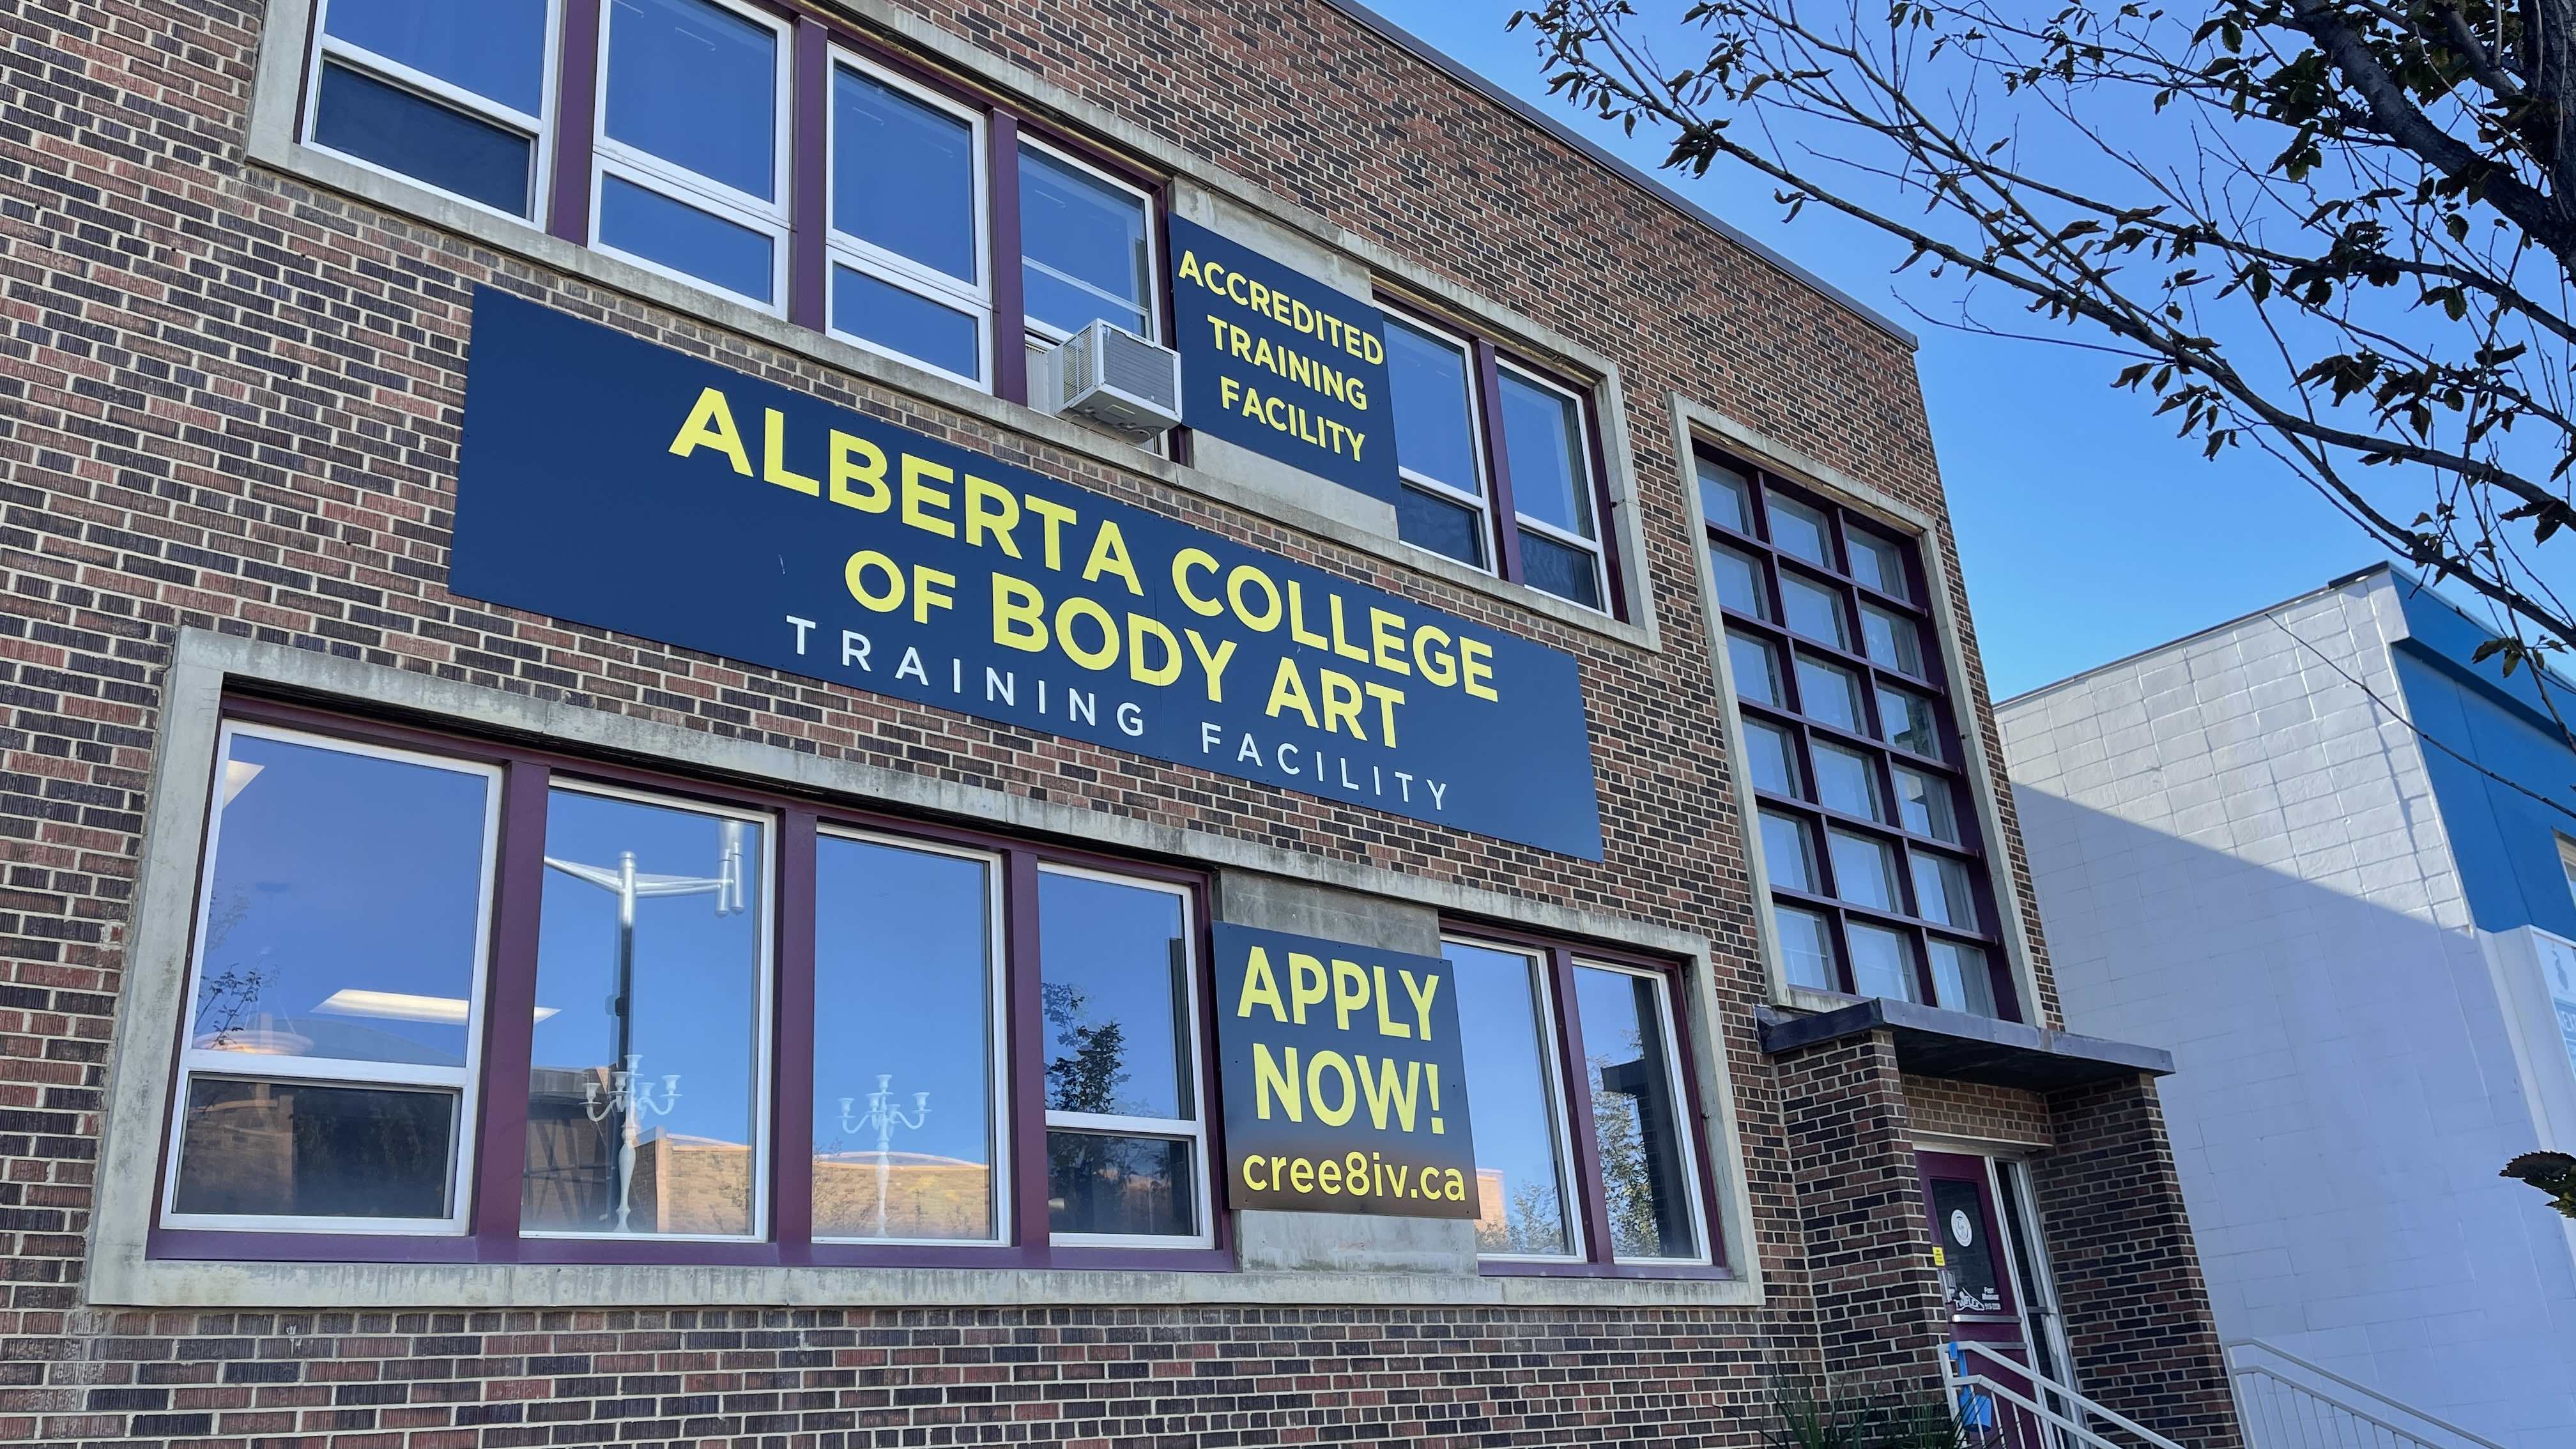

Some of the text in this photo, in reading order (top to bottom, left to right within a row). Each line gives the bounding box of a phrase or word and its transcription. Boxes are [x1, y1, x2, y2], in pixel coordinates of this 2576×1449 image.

[1178, 250, 1384, 365] ACCREDITED
[1207, 314, 1367, 410] TRAINING
[1220, 375, 1365, 462] FACILITY
[668, 387, 1498, 703] ALBERTA COLLEGE
[845, 550, 1405, 748] OF BODY ART
[786, 615, 1446, 810] TRAINING FACILITY
[1237, 946, 1439, 1041] APPLY
[1252, 1043, 1445, 1135] NOW!
[1242, 1151, 1466, 1201] cree8iv.ca
